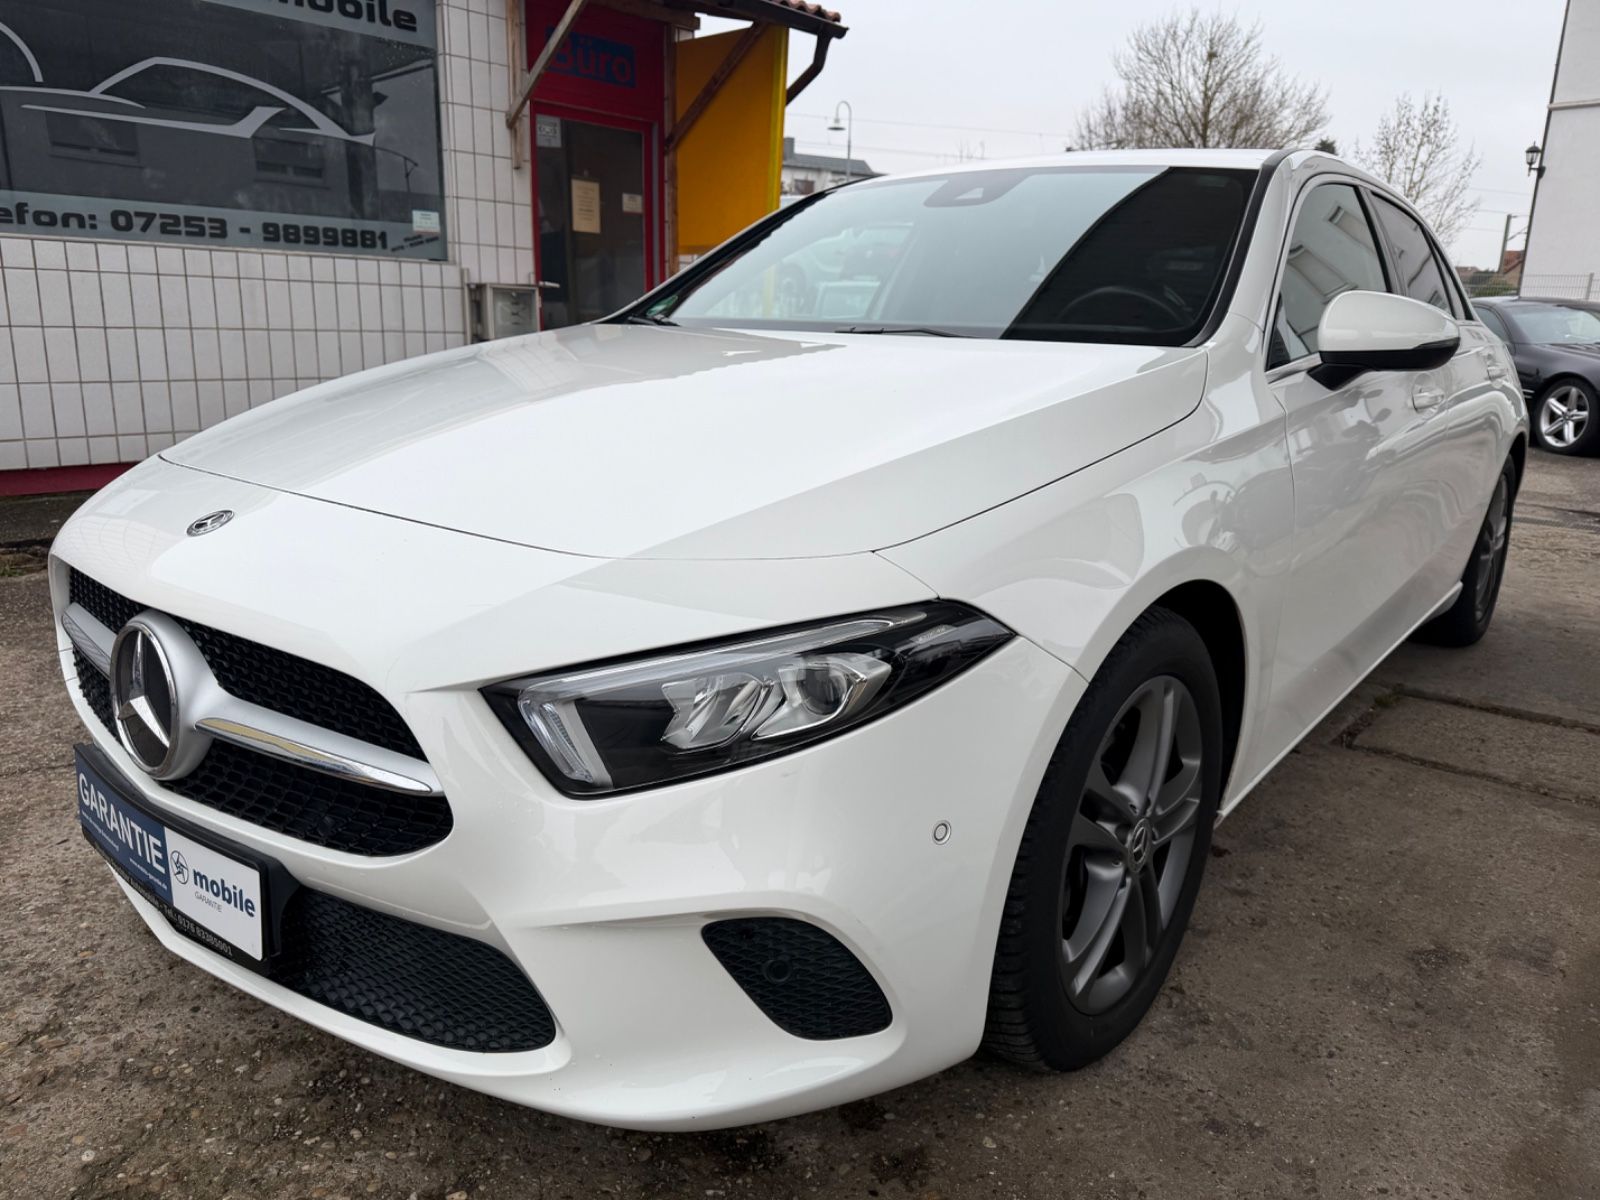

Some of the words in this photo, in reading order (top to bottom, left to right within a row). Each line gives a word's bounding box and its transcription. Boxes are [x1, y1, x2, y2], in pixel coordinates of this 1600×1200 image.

[278, 0, 417, 32] obile
[110, 210, 227, 239] 07253
[262, 222, 387, 249] 9899881
[79, 773, 165, 874] GARANTIE
[193, 868, 255, 917] mobile
